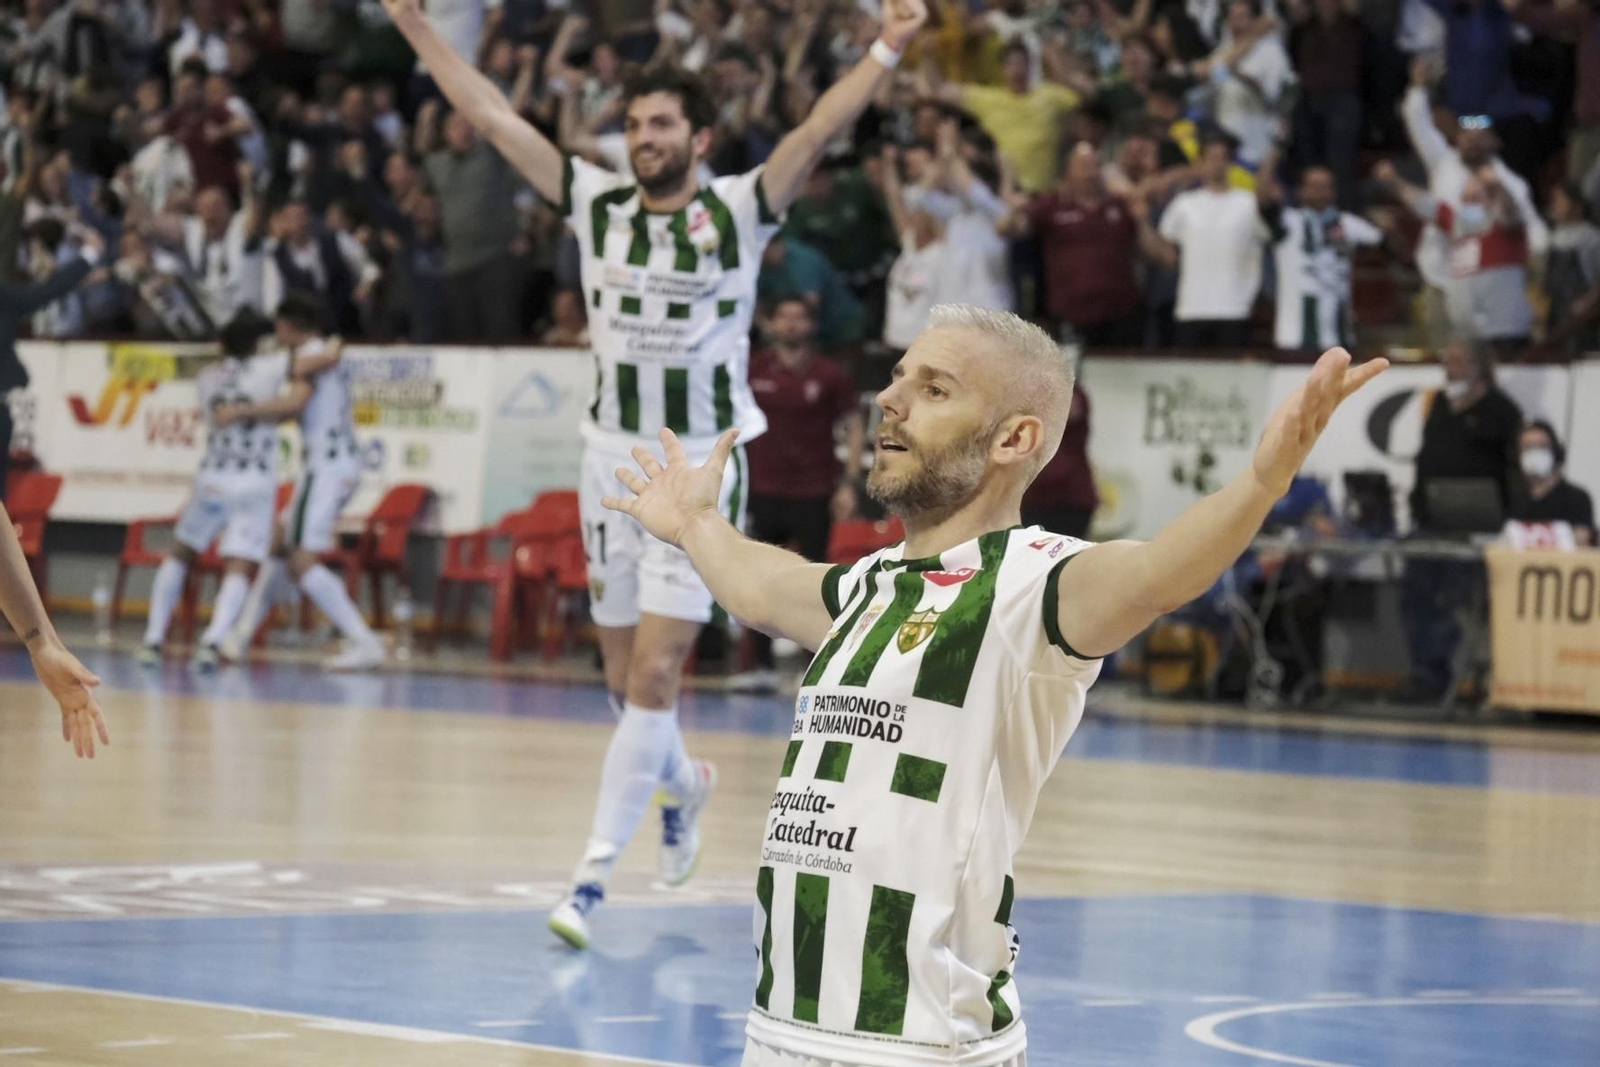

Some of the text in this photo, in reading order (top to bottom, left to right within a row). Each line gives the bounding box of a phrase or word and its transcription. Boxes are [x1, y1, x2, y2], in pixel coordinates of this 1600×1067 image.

[813, 695, 908, 718] PATRIMONIO DE
[893, 713, 905, 722] LA
[808, 715, 903, 743] HUMANIDAD
[805, 853, 852, 873] Córdoba
